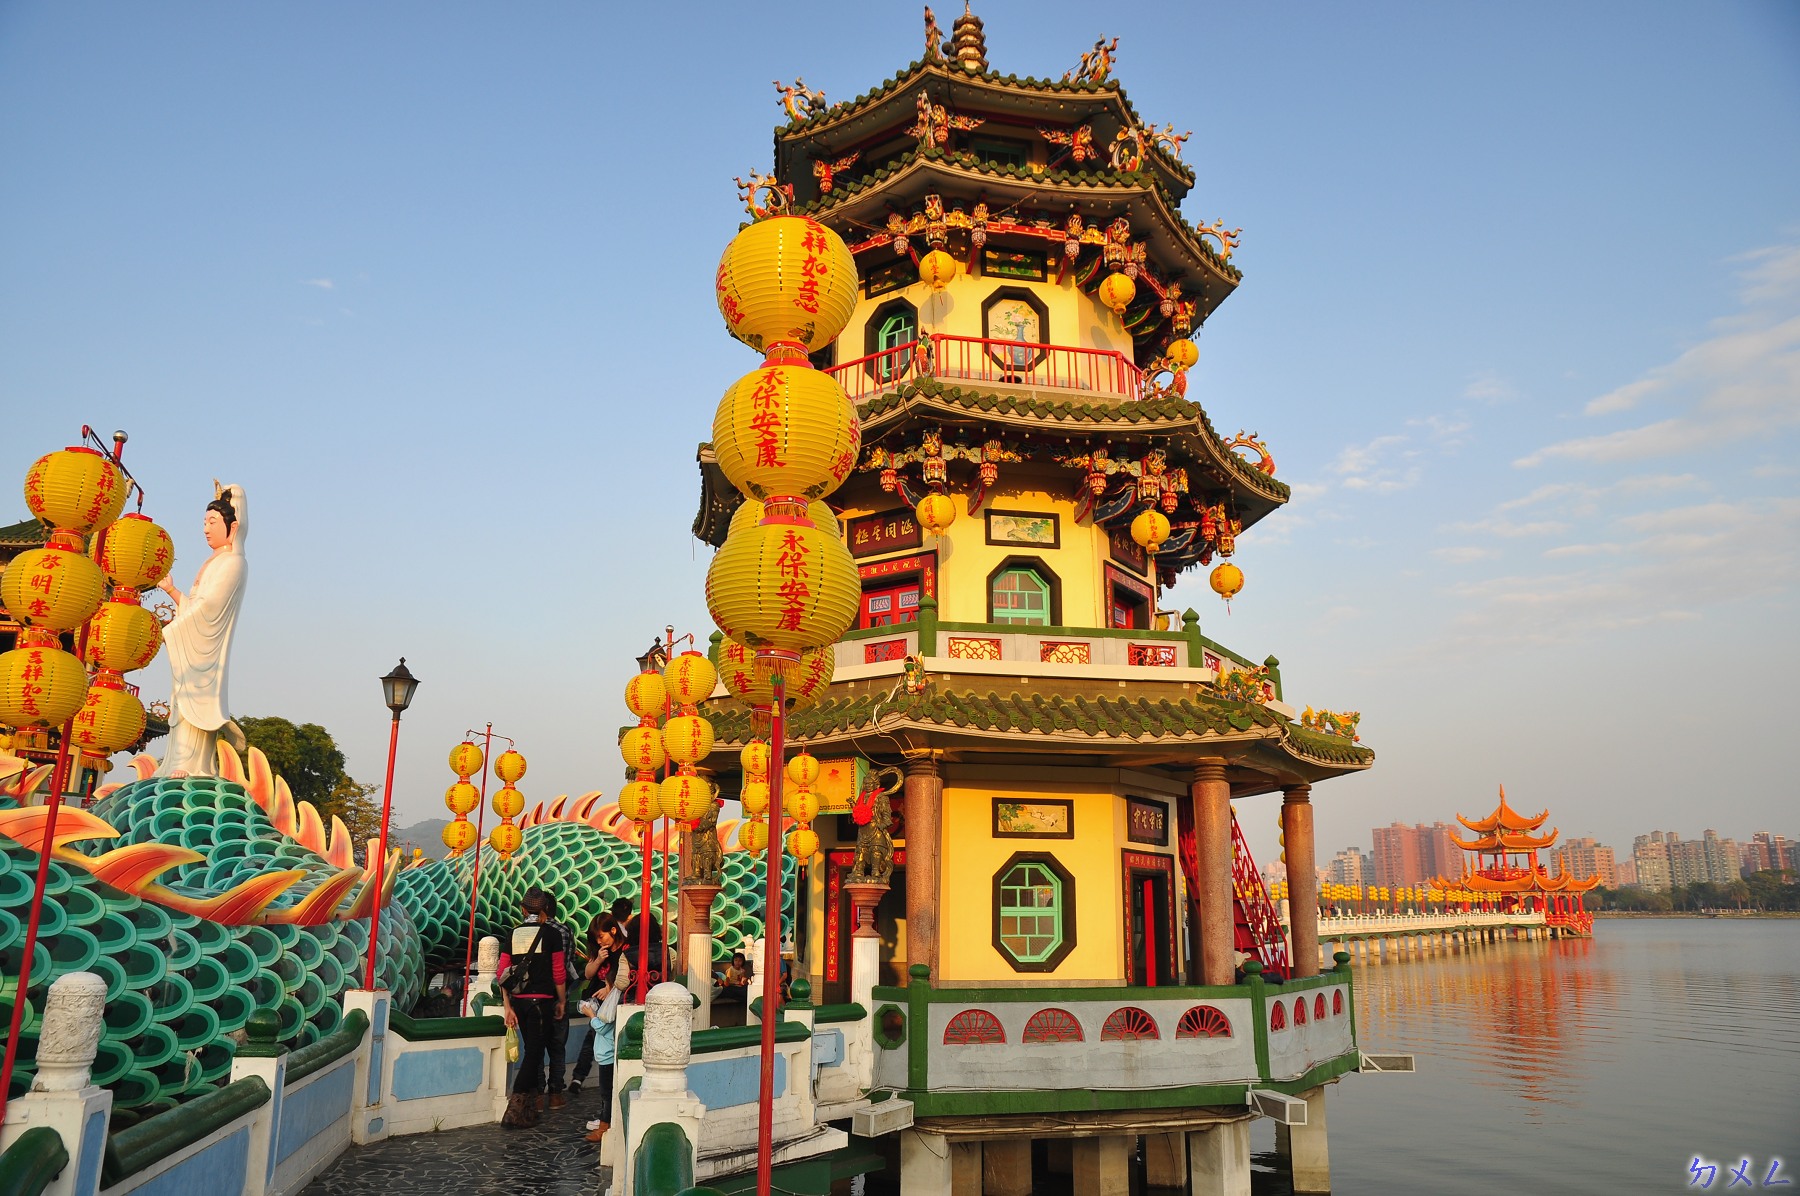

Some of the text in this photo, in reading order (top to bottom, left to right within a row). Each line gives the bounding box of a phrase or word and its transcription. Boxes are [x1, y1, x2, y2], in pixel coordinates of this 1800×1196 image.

[749, 368, 786, 468] 永保安康
[829, 392, 861, 482] 安燈
[82, 461, 115, 524] 吉祥如意
[142, 529, 171, 581] 平安燈
[776, 529, 810, 633] 永保安康
[18, 650, 45, 717] 吉祥如意
[678, 658, 691, 697] 永保安康
[639, 731, 652, 765] 平安燈
[636, 785, 651, 816] 平安燈
